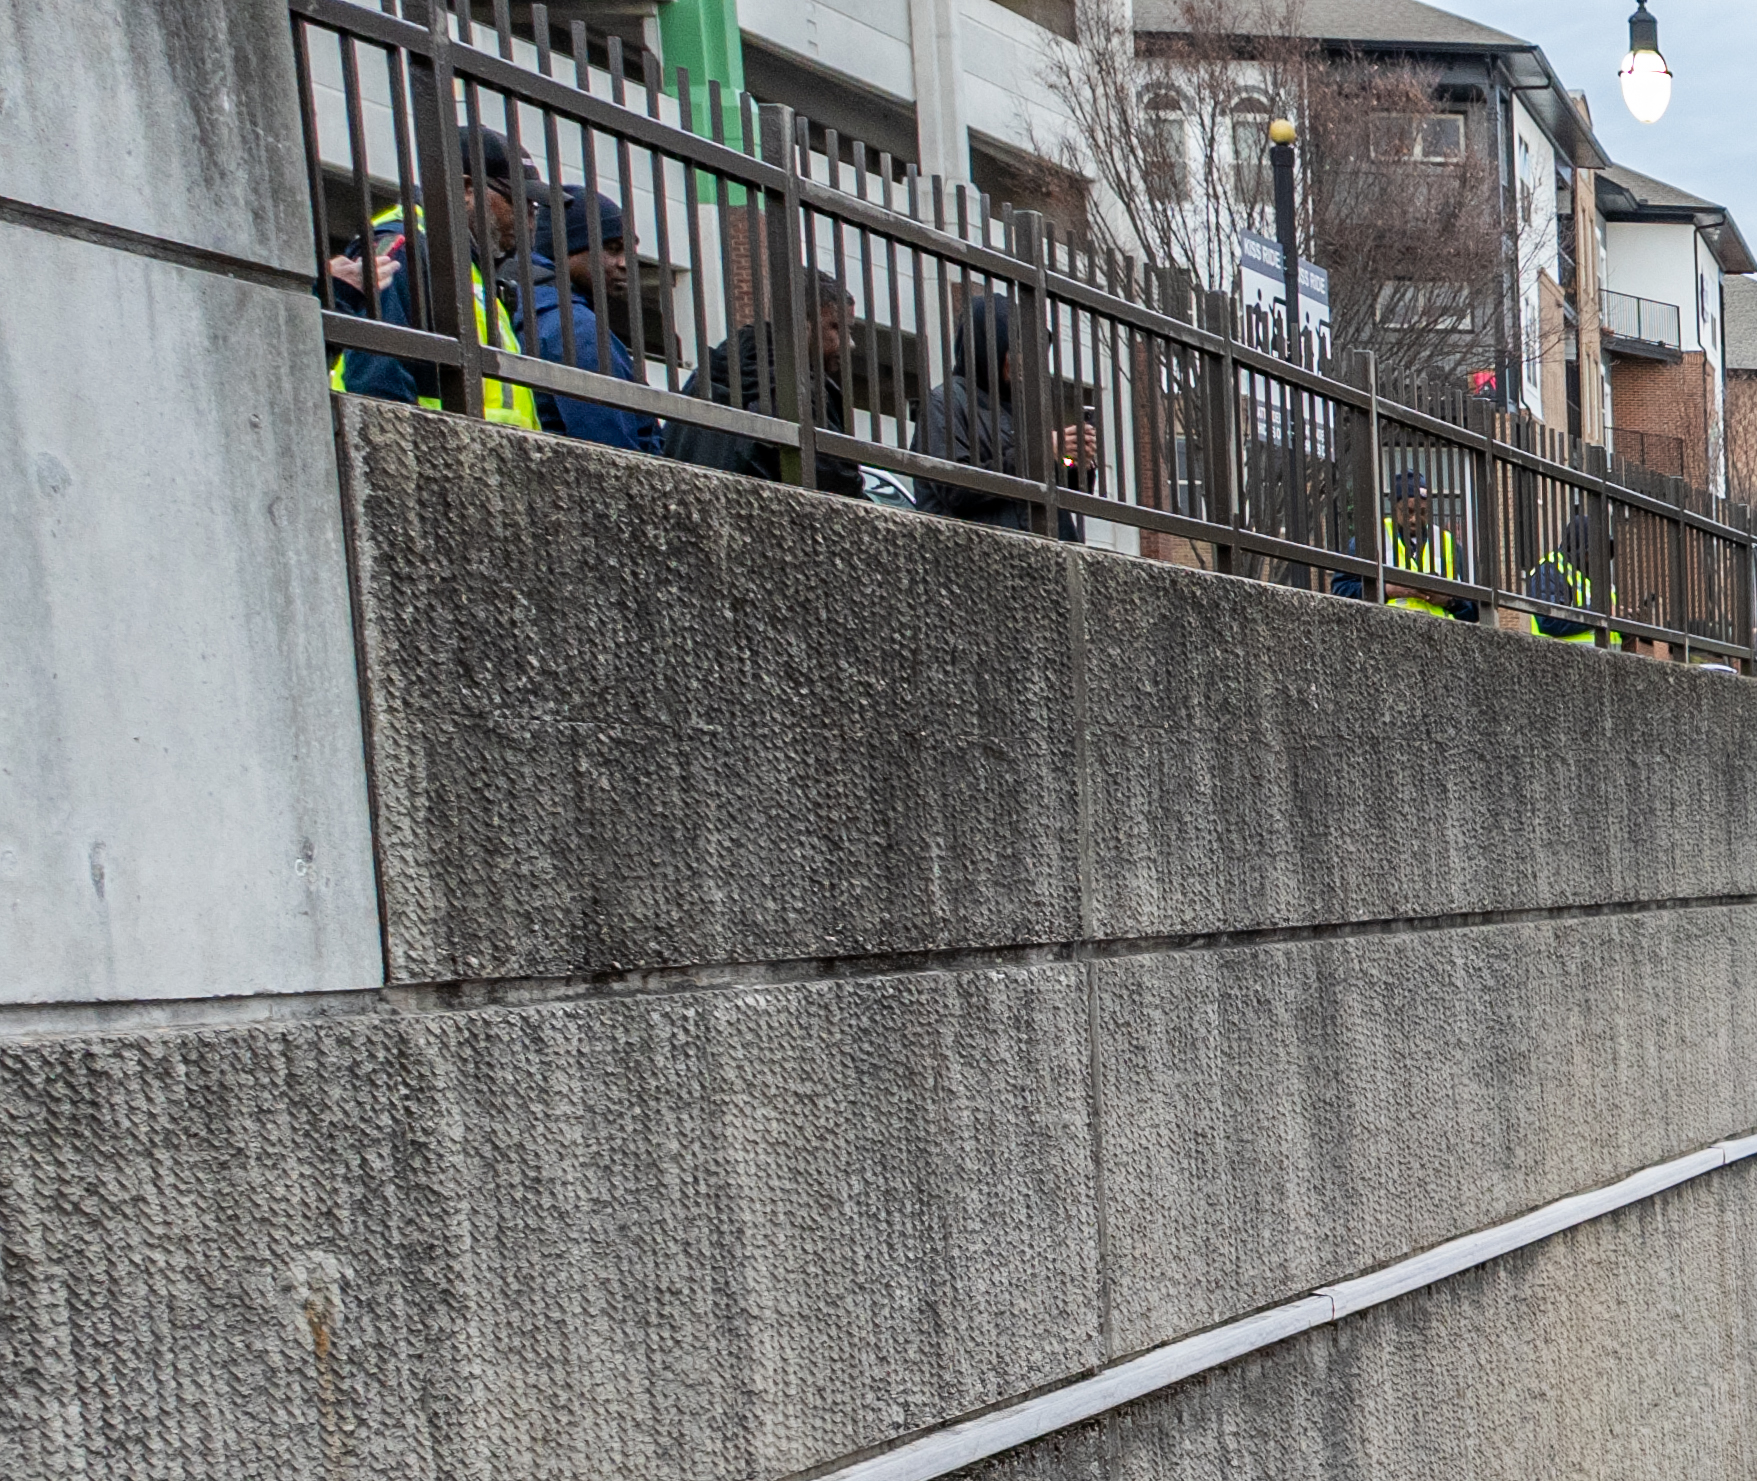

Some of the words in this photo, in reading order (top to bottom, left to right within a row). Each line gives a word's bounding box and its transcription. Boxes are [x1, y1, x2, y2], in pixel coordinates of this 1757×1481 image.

[1243, 238, 1263, 262] KISS
[1262, 246, 1282, 270] RIDE
[1310, 272, 1327, 295] RIDE
